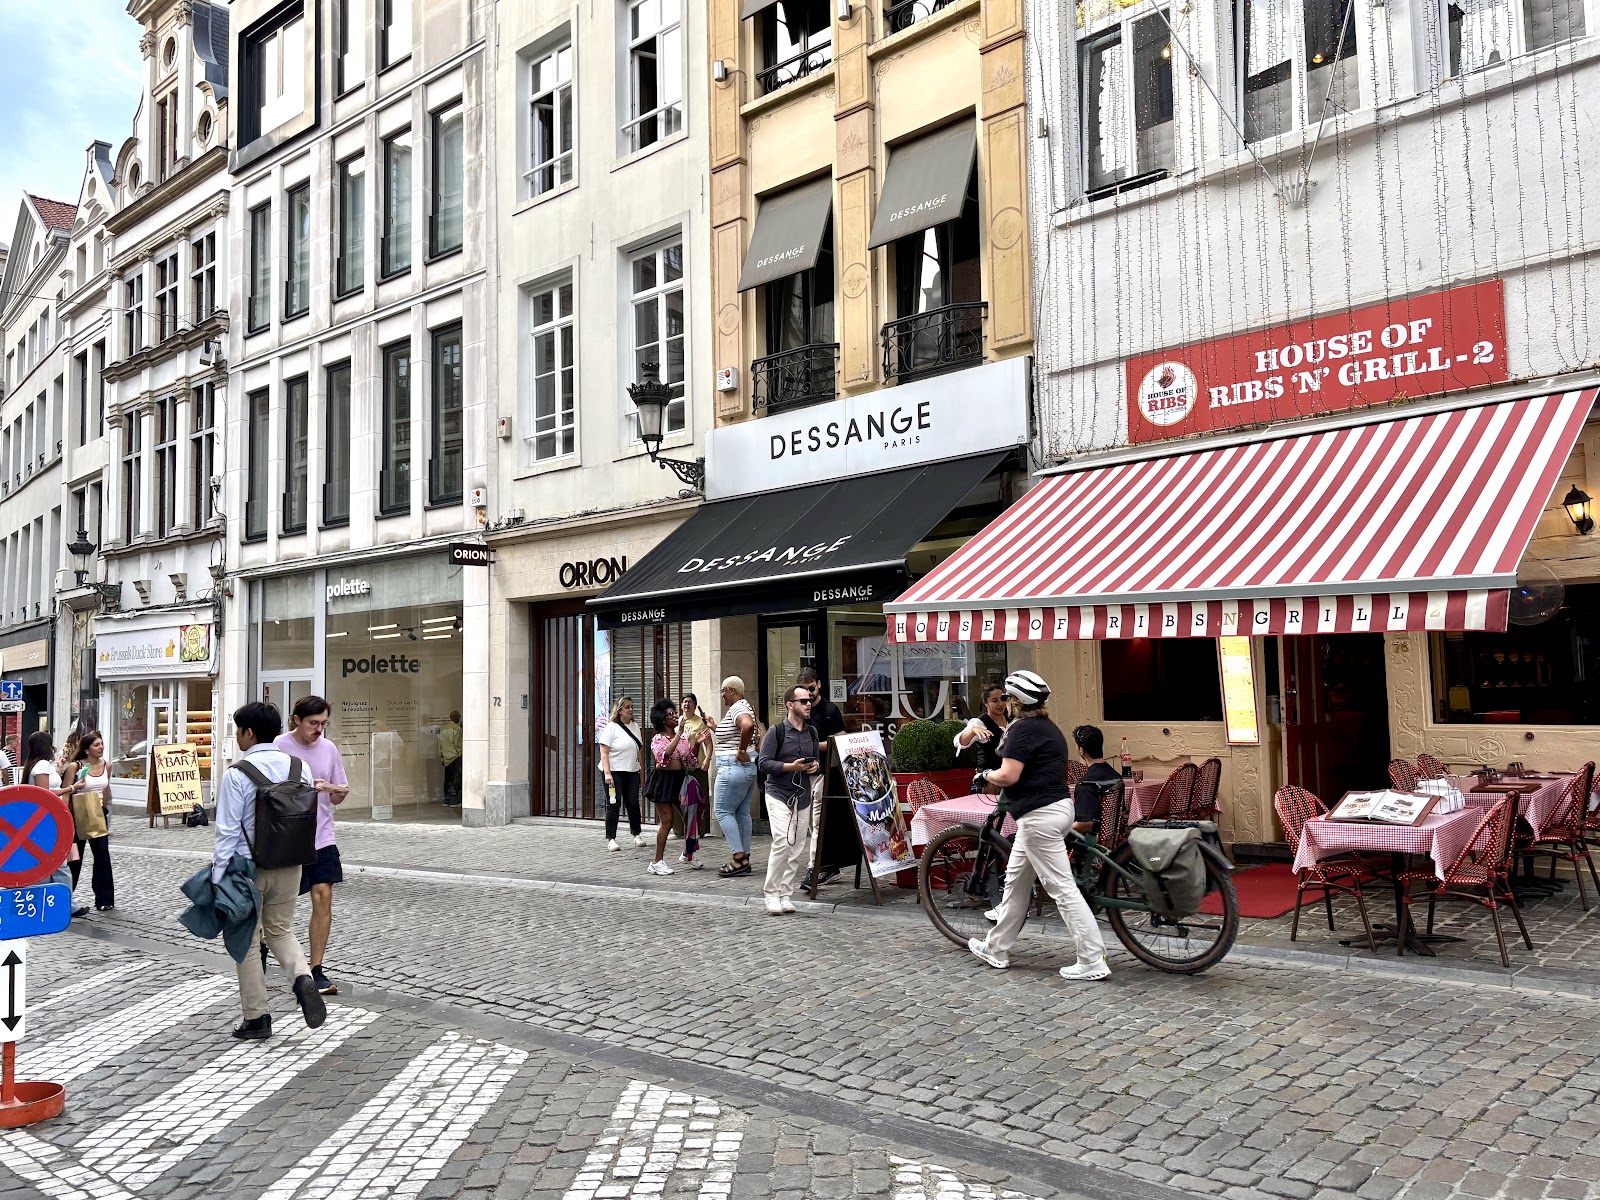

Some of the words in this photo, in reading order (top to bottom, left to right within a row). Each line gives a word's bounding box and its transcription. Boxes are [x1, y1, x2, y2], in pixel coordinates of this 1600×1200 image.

[890, 194, 947, 222] DESSANGE
[757, 245, 804, 268] DESSANGE
[1254, 330, 1373, 373] HOUSE
[1380, 317, 1432, 348] OF
[1148, 389, 1173, 399] HOUSE
[1208, 375, 1285, 409] RIBS
[1148, 395, 1187, 412] RIBS
[770, 401, 931, 460] DESSANGE
[884, 435, 920, 450] PARIS
[454, 549, 487, 560] ORION
[677, 535, 852, 573] DESSANGE
[559, 556, 628, 588] ORION
[326, 578, 369, 603] polette
[813, 585, 873, 601] DESSANGE
[621, 608, 666, 623] DESSANGE
[896, 619, 993, 635] HOUSE
[1031, 618, 1066, 631] OF
[1109, 613, 1205, 629] RIBS
[1254, 606, 1405, 625] GRILL
[110, 646, 132, 661] Brussels
[132, 645, 147, 660] Duck
[147, 643, 163, 659] Store
[1393, 640, 1411, 653] 76
[342, 654, 421, 678] polette
[493, 696, 501, 707] 72
[165, 756, 189, 767] BAR
[158, 770, 198, 783] THEATRE
[163, 790, 199, 803] TOONE
[13, 890, 35, 902] 26
[15, 903, 37, 917] 29
